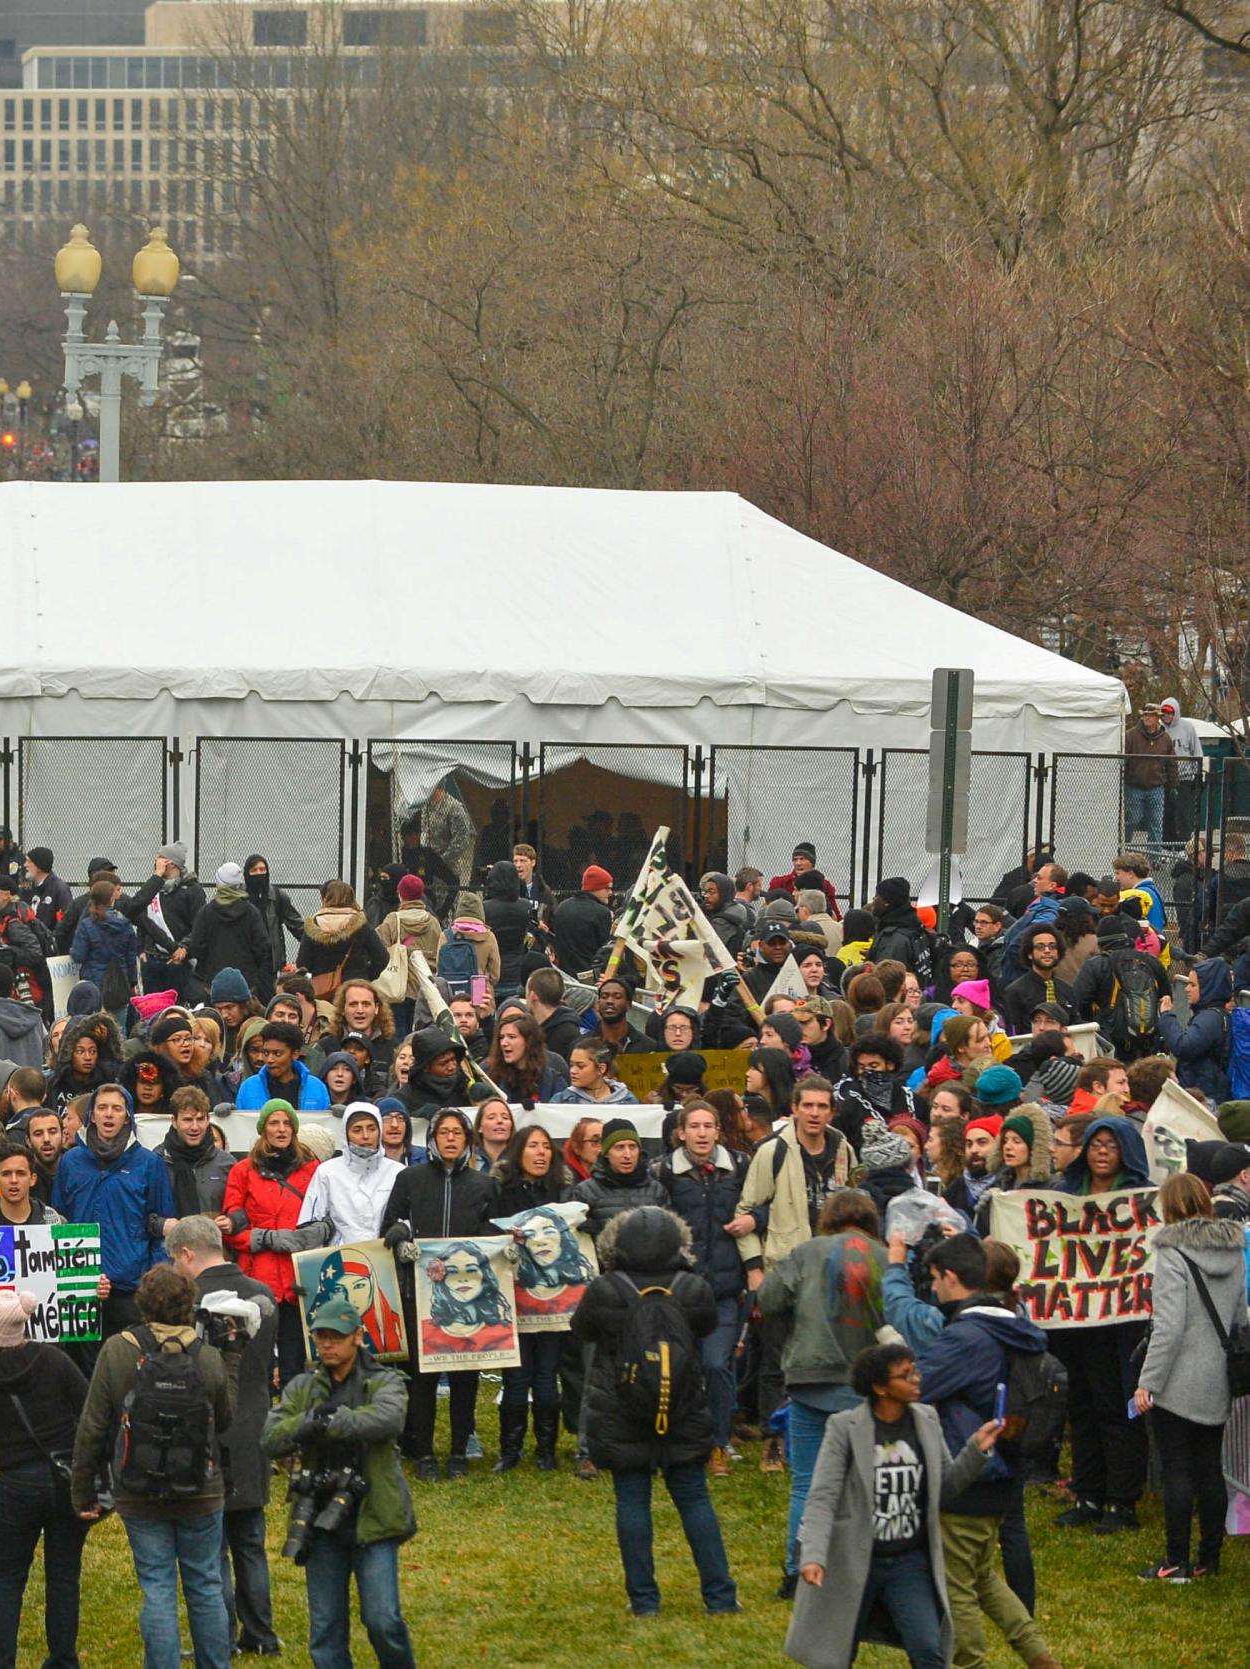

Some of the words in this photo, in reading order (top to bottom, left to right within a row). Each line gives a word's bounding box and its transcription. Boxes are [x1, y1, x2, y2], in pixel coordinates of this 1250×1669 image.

[1025, 1191, 1162, 1240] BLACK
[13, 1229, 101, 1278] también
[1030, 1234, 1147, 1281] LIVES
[24, 1291, 101, 1340] mérica
[1019, 1272, 1155, 1321] MATTER
[875, 1464, 924, 1494] ETTY
